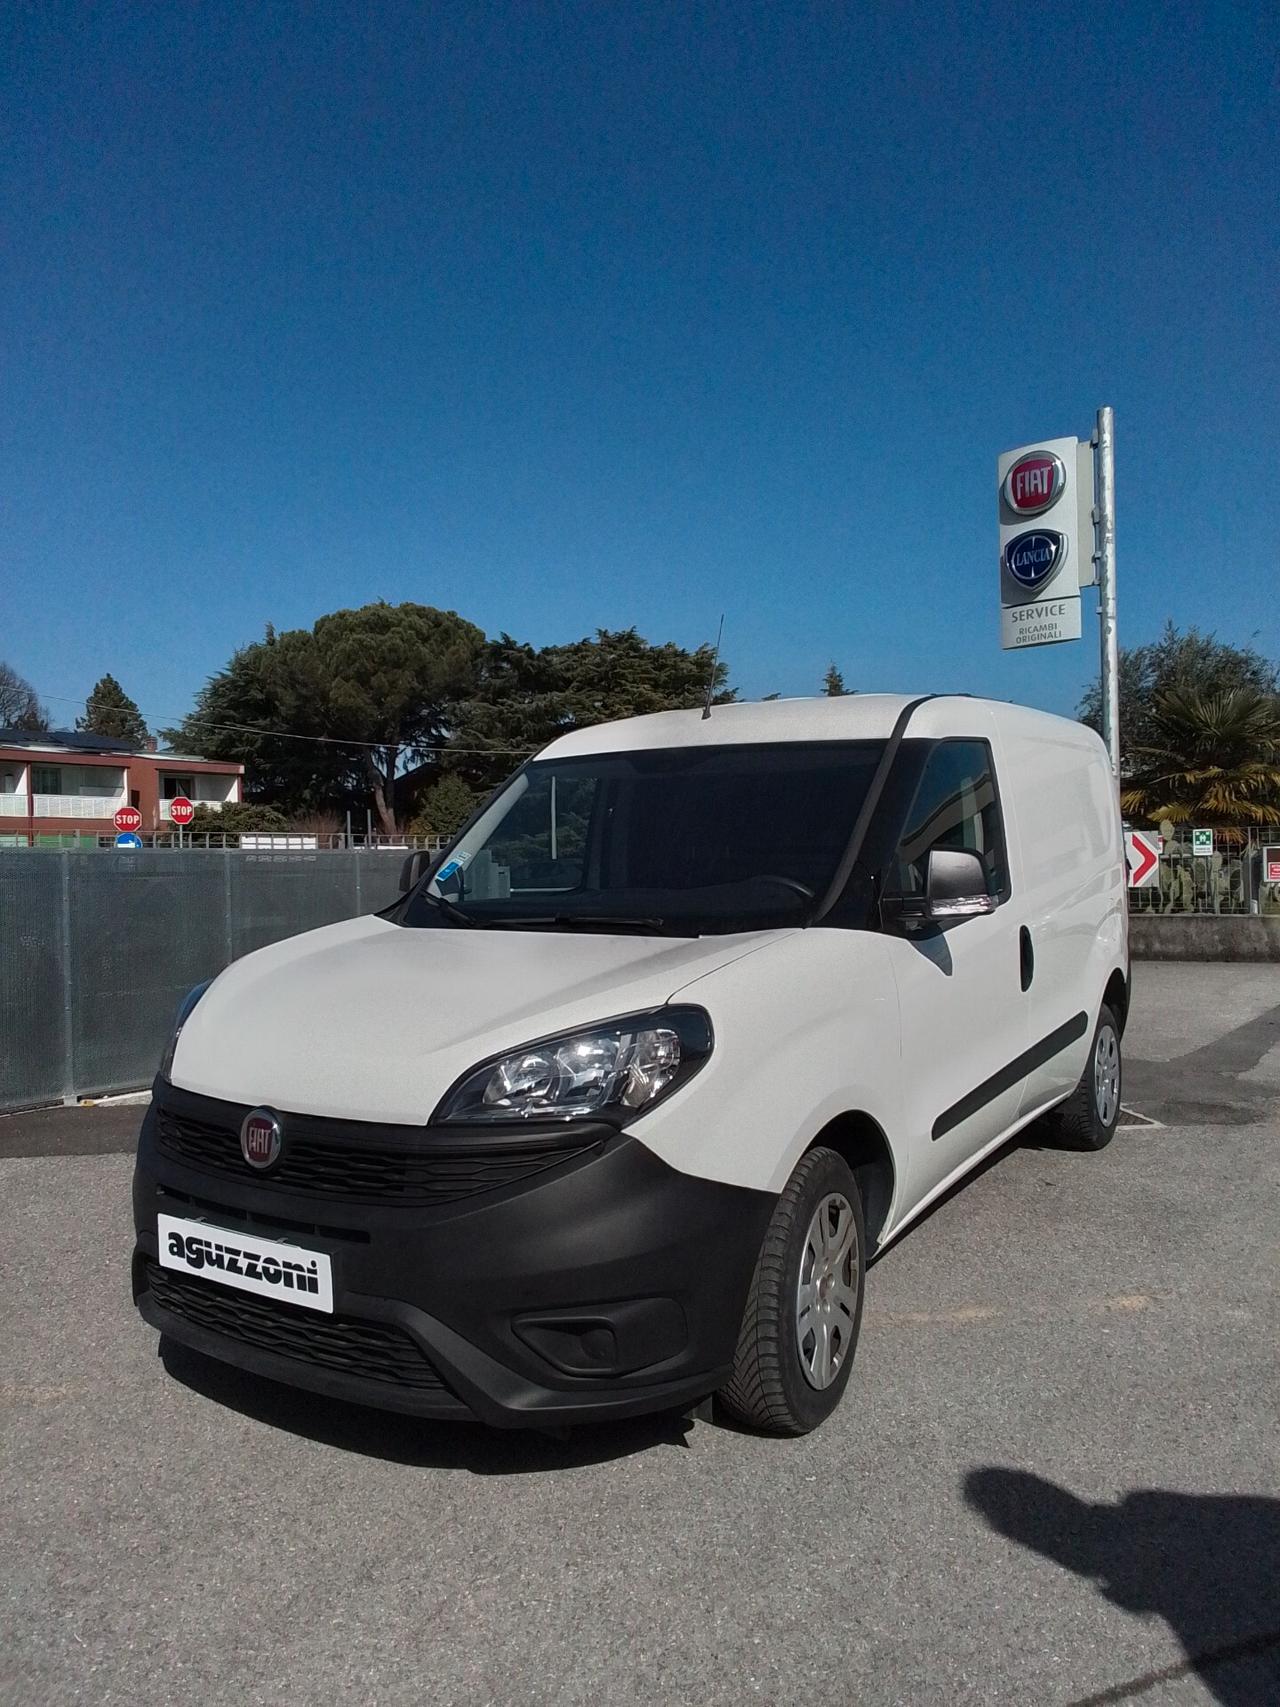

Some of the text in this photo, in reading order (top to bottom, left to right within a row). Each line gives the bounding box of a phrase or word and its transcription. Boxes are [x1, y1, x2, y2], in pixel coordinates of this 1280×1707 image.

[1016, 466, 1052, 500] FIAT
[1016, 547, 1051, 567] LANCIA
[1011, 603, 1066, 623] SERVICE
[1016, 630, 1062, 644] ORIGINALI
[1019, 623, 1058, 635] RICAMBI
[116, 814, 140, 825] STOP
[171, 805, 192, 816] STOP
[249, 1126, 271, 1154] FIAT
[168, 1231, 319, 1295] aguzzoni
